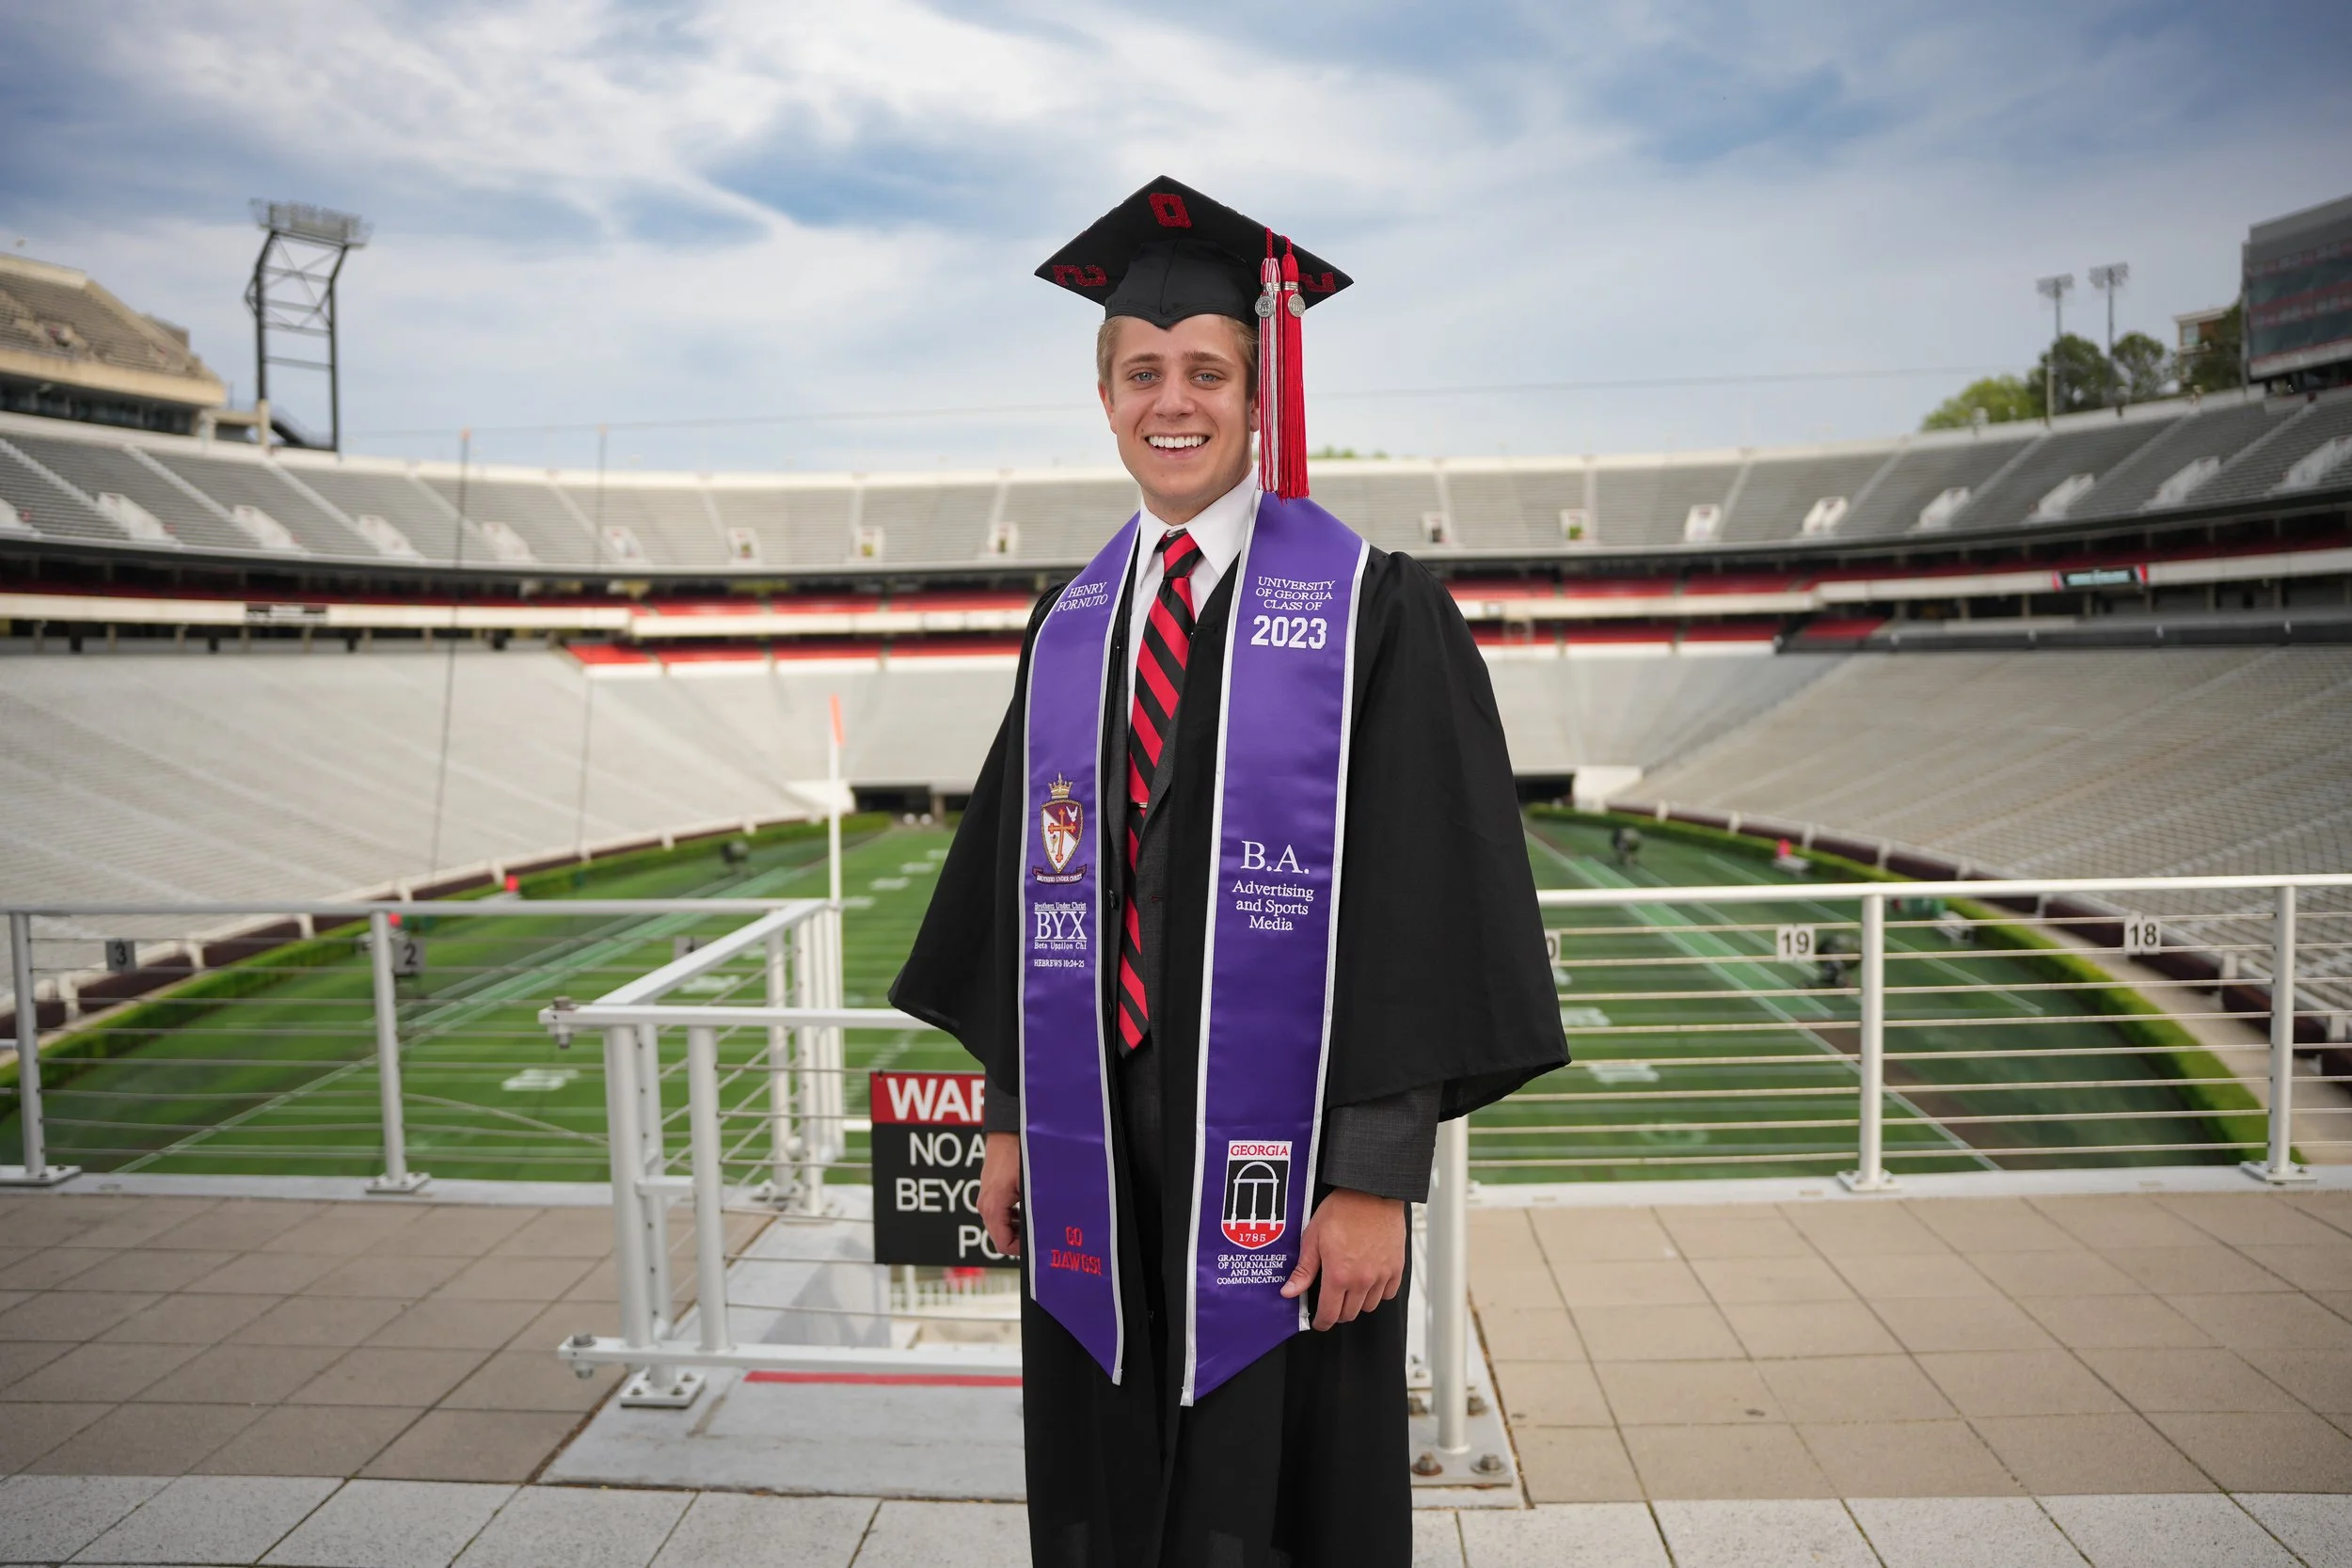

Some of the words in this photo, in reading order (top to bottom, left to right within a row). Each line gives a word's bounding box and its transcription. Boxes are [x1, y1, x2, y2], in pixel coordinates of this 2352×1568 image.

[1068, 582, 1107, 598] HENRY
[1258, 576, 1336, 591] UNIVERSITY
[1056, 594, 1108, 612] FORNUTO
[1255, 587, 1273, 597] OF
[1274, 590, 1333, 600] GEORGIA
[1263, 599, 1303, 610] CLASS
[1305, 602, 1323, 610] OF
[1250, 614, 1327, 649] 2023
[1240, 840, 1310, 875] B.A.
[1232, 879, 1315, 902] Advertising
[1235, 898, 1262, 912] and
[1265, 899, 1309, 917] Sports
[1034, 911, 1088, 940] BYX
[1248, 914, 1294, 931] Media
[1781, 931, 1809, 955] 19
[2129, 922, 2156, 946] 18
[115, 942, 127, 967] 3
[403, 942, 417, 966] 2
[1034, 942, 1048, 950] Beta
[1050, 942, 1073, 951] Upsilon
[1034, 958, 1062, 968] HEBREWS
[909, 1132, 962, 1167] NO
[1230, 1145, 1289, 1156] GEORGIA
[1065, 1226, 1083, 1247] GO
[1238, 1233, 1266, 1243] 1785
[1050, 1249, 1103, 1276] DAWGS!
[1216, 1275, 1286, 1285] COMMUNICATION
